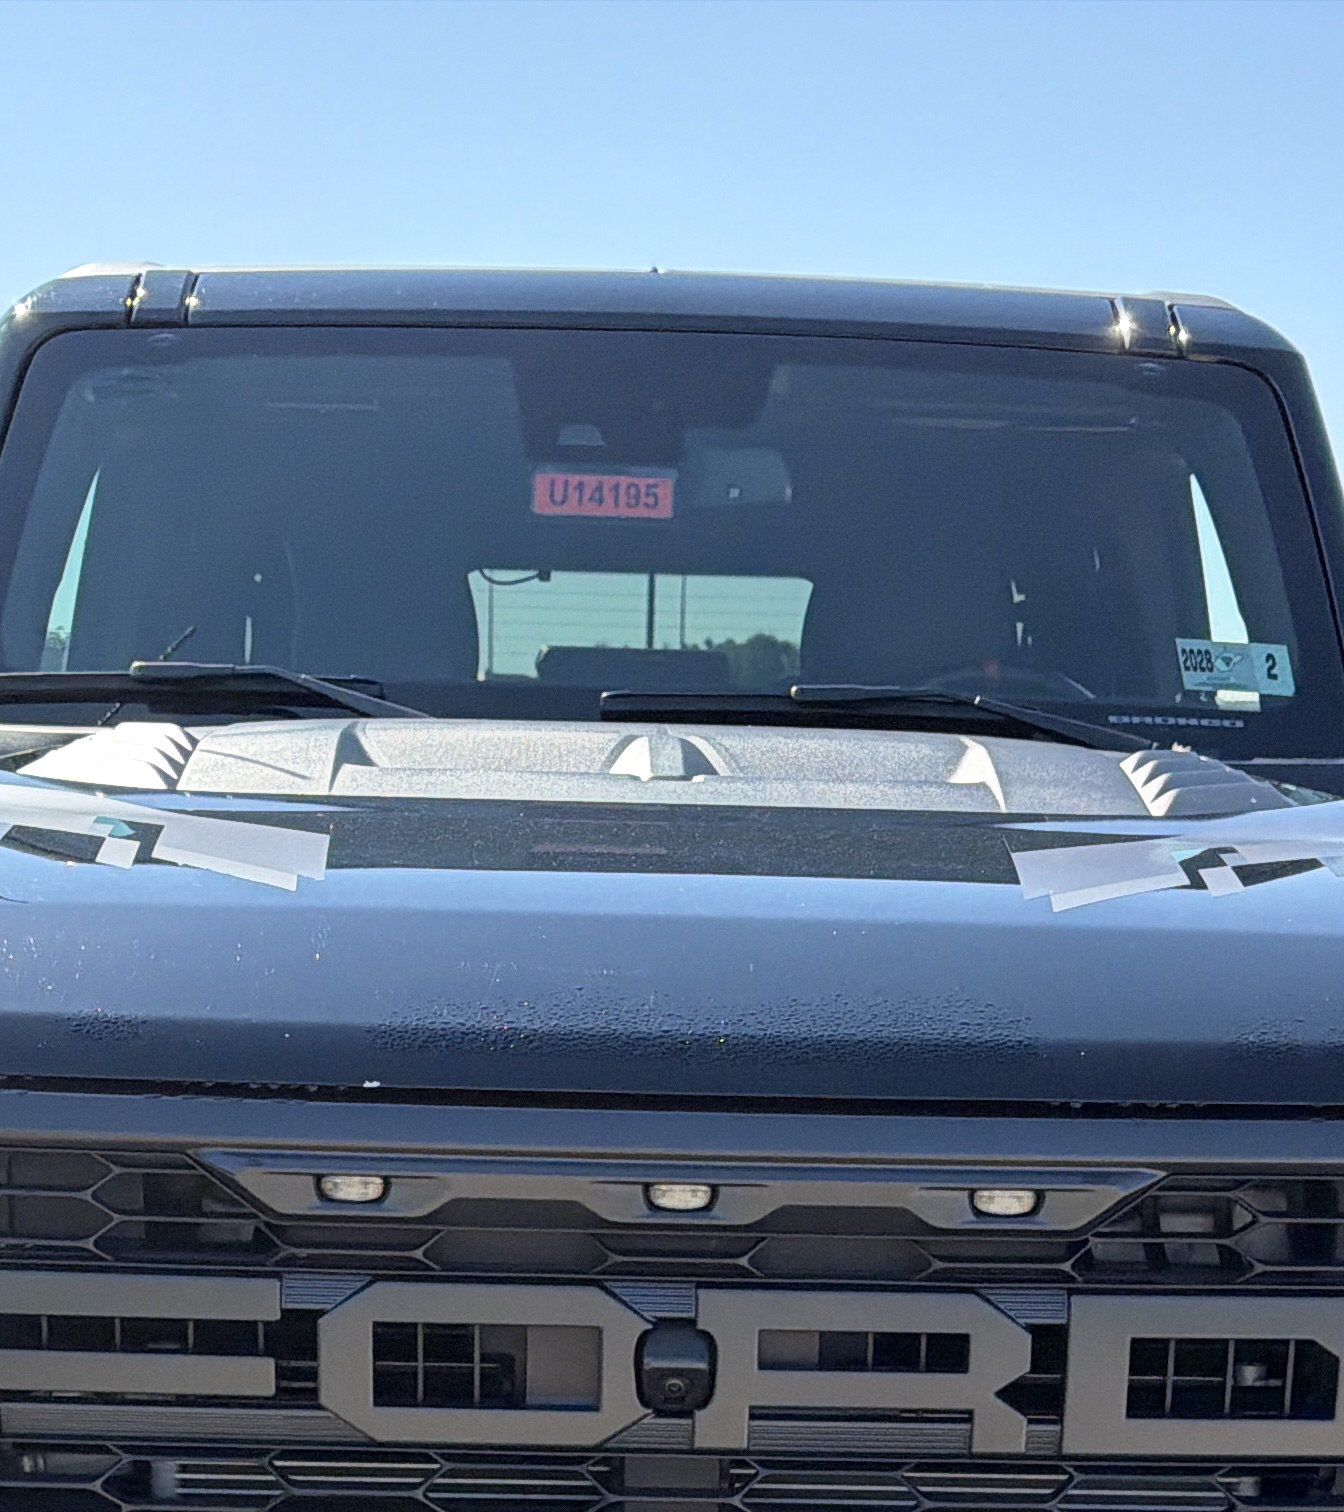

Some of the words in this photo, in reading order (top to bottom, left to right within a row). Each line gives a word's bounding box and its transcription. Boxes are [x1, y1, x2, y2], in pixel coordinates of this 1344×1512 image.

[549, 479, 659, 509] U14195
[1181, 649, 1215, 672] 2028
[1265, 653, 1279, 681] 2
[1108, 715, 1245, 728] BRONCO
